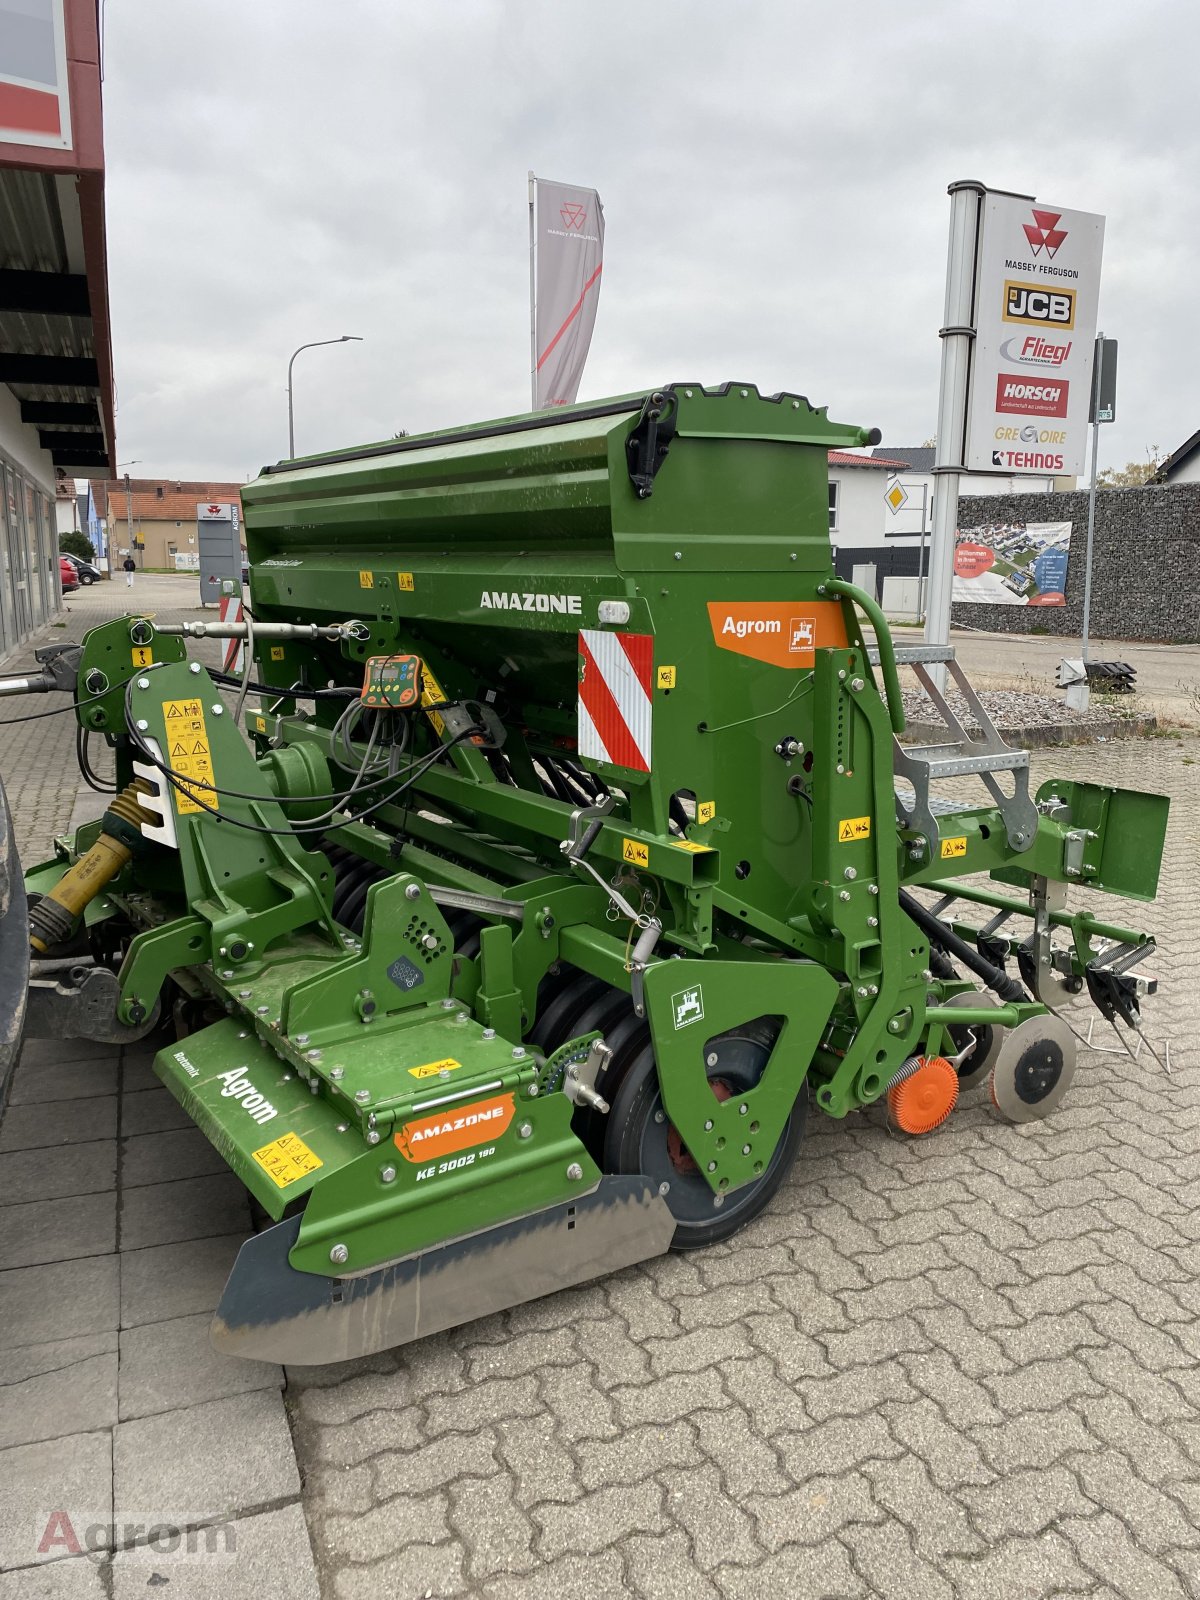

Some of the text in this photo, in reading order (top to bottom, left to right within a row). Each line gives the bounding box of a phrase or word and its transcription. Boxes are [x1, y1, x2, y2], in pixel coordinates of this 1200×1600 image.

[1005, 260, 1079, 278] MASSEY FERGUSON
[1009, 291, 1070, 321] JCB
[1021, 336, 1073, 364] Fliegl
[1004, 383, 1061, 402] HORSCH
[995, 425, 1067, 444] GREGOIRE
[1006, 451, 1064, 470] TEHNOS
[480, 591, 582, 615] AMAZONE
[722, 616, 781, 638] Agrom
[173, 1052, 200, 1078] Rotamix
[217, 1066, 278, 1125] Agrom
[410, 1107, 504, 1143] AMAZONE
[416, 1147, 496, 1181] KE 3002 190
